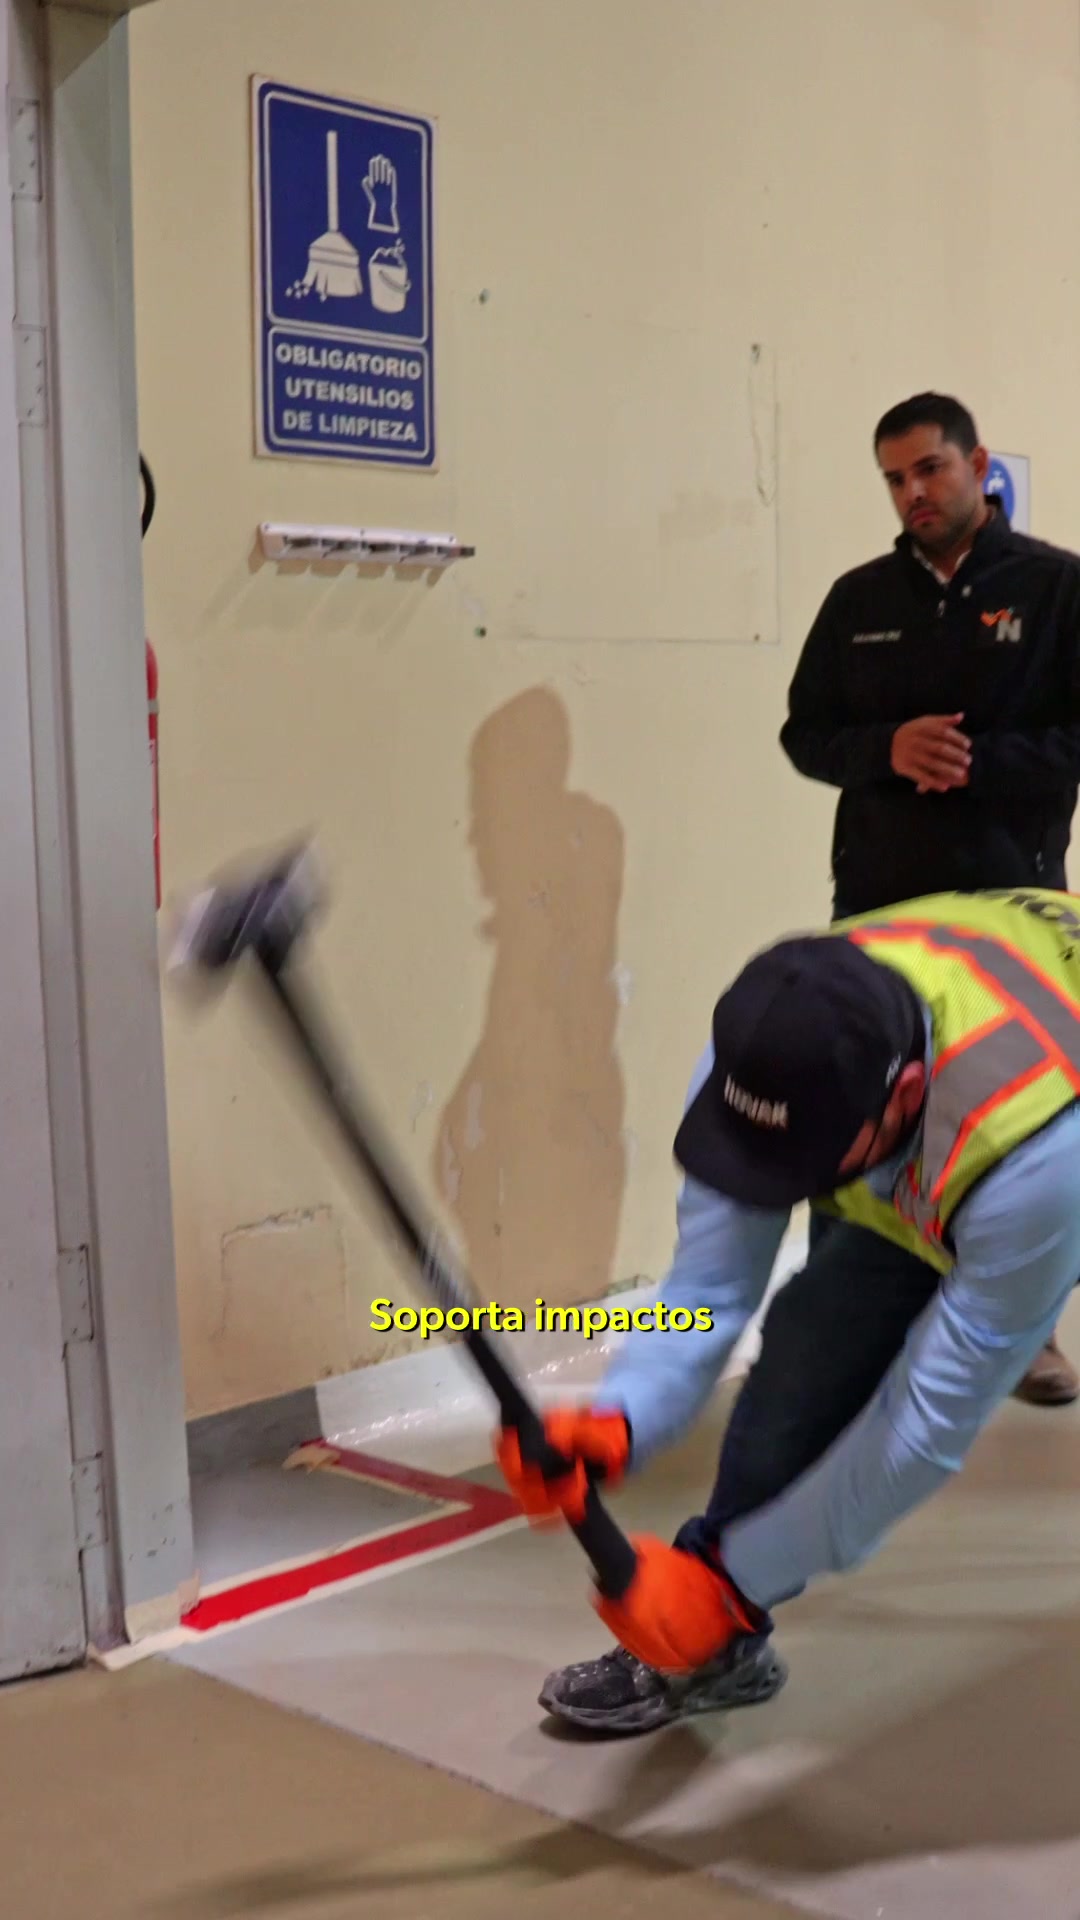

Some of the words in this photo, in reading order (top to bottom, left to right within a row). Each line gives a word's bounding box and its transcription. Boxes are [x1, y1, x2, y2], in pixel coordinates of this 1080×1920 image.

[276, 343, 421, 379] OBLIGATORIO
[286, 377, 414, 410] UTENSILIOS
[283, 411, 312, 431] DE
[319, 414, 417, 442] LIMPIEZA
